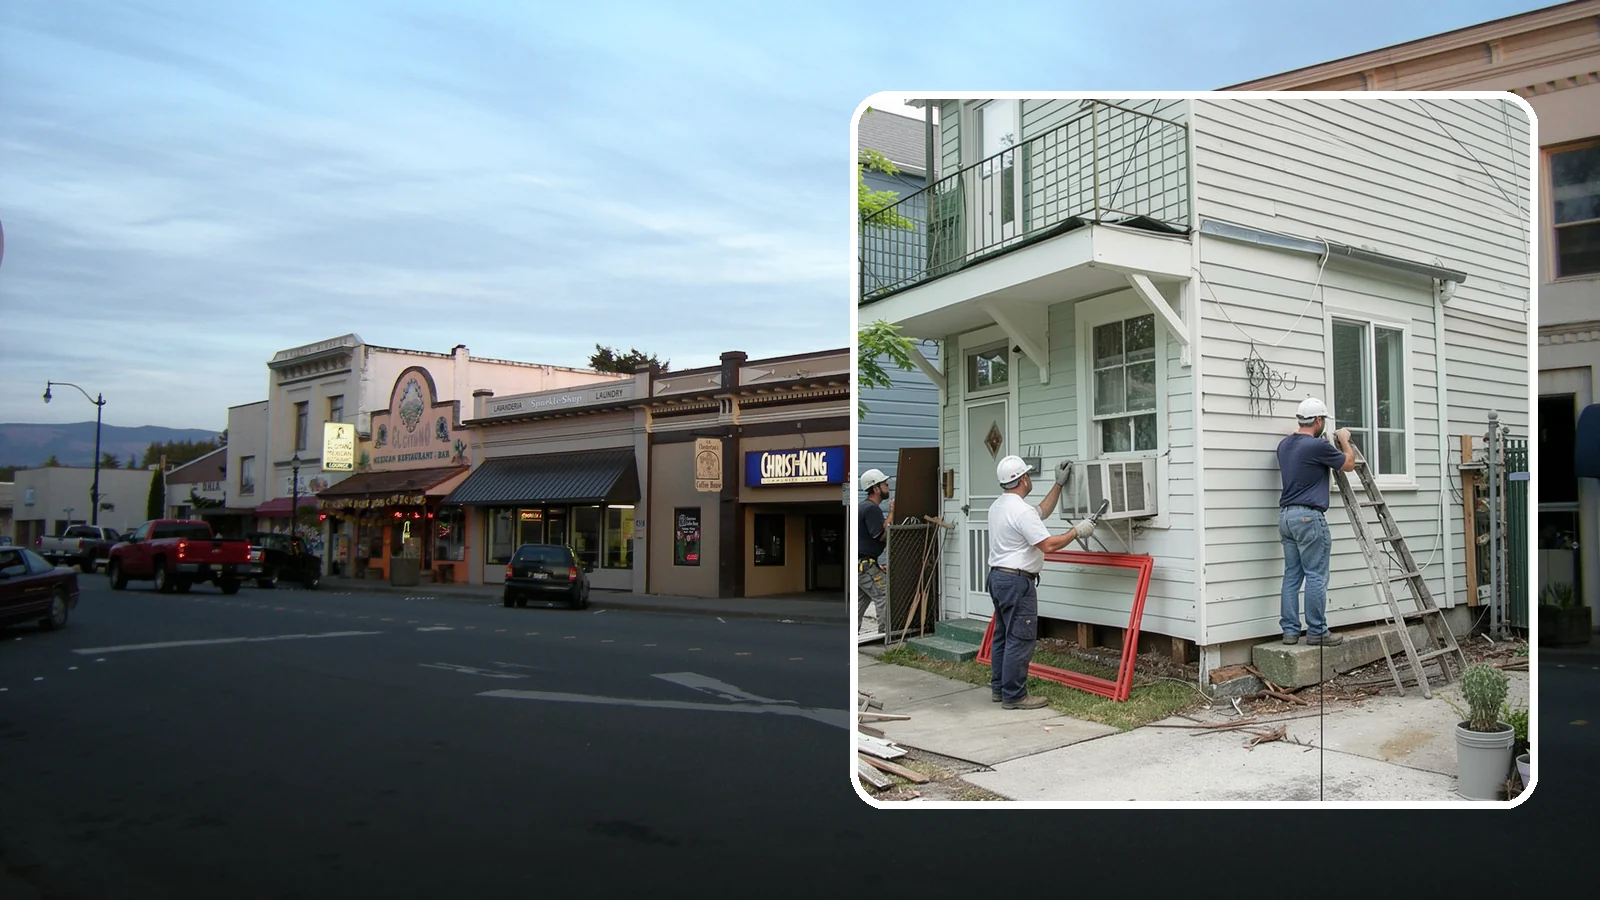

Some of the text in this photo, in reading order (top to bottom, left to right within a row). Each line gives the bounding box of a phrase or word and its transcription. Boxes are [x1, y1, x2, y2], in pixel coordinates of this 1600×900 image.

[531, 394, 582, 409] Sparkle Shop
[595, 389, 623, 400] LAUNDRY
[493, 402, 522, 412] LAVANDERIA
[392, 425, 401, 449] EL
[373, 455, 396, 464] MEXICAN
[398, 451, 433, 462] RESTAURANT
[438, 450, 450, 459] BAR
[761, 450, 827, 478] CHRIST KING
[697, 480, 722, 489] Coffee House
